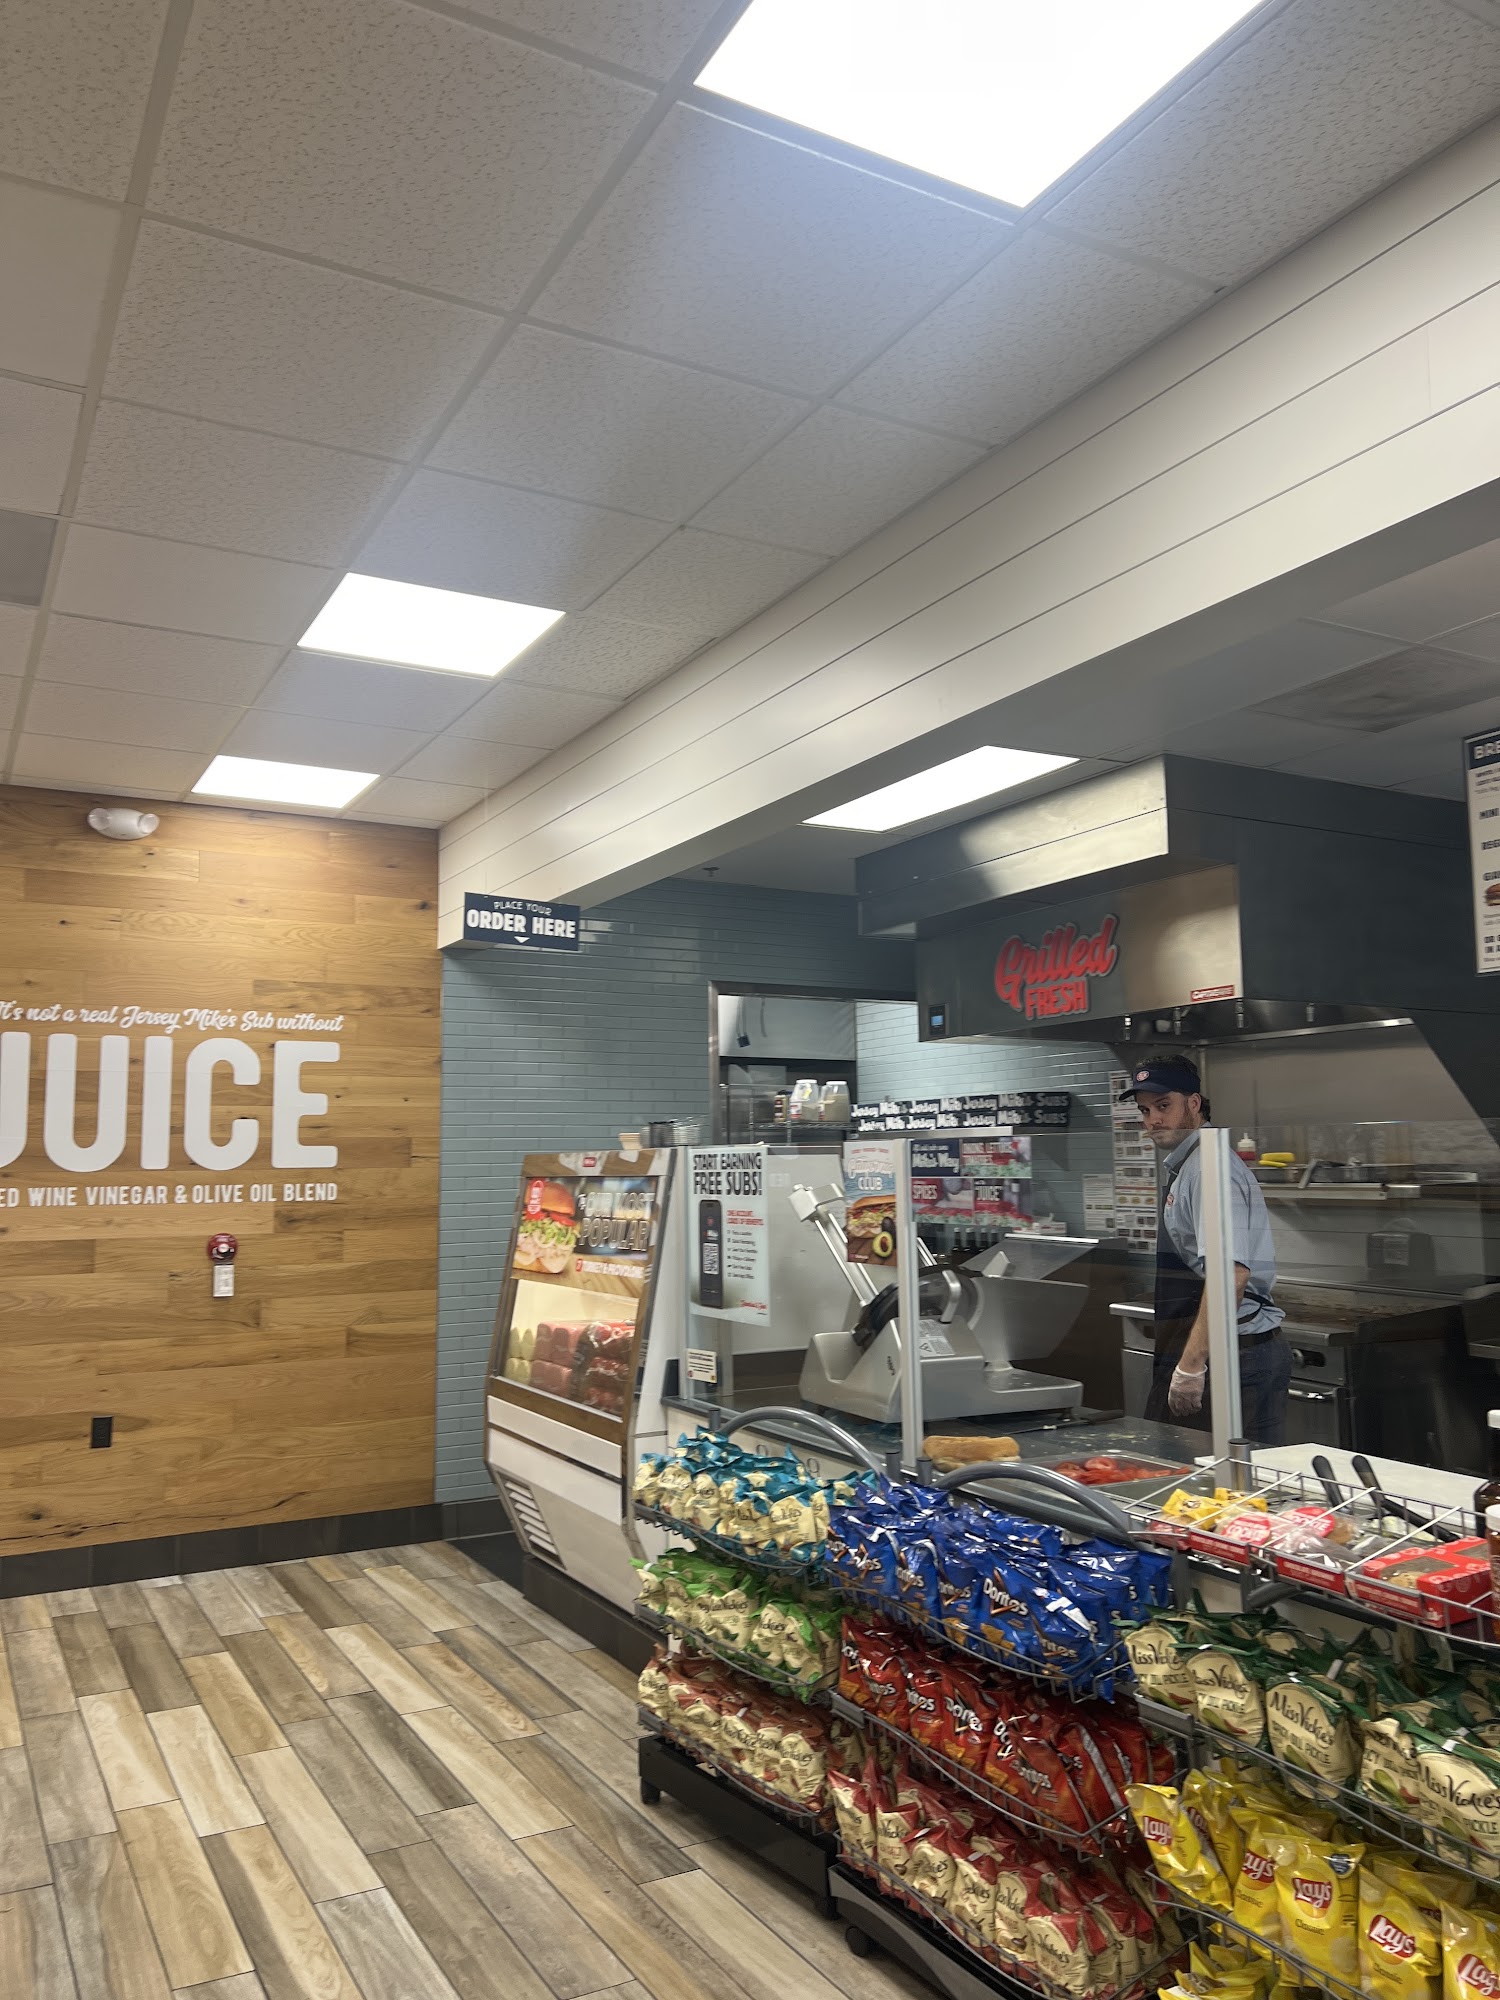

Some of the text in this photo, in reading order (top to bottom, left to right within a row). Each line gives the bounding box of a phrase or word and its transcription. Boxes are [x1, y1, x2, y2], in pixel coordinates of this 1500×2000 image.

[466, 909, 576, 939] ORDER HERE
[493, 901, 552, 916] PLACE YOUR
[996, 915, 1117, 1011] Grilled
[1025, 980, 1087, 1019] FRESH
[26, 1003, 62, 1021] not
[62, 1009, 78, 1022] a
[79, 1006, 119, 1024] real
[120, 1005, 182, 1034] Jersey
[183, 1008, 237, 1032] Mike's
[240, 1010, 274, 1032] Sub
[276, 1013, 344, 1032] without
[694, 1154, 718, 1170] START
[28, 1187, 78, 1207] WINE
[86, 1185, 168, 1205] VINEGAR
[175, 1185, 187, 1204] &
[192, 1184, 244, 1204] OLIVE
[251, 1183, 277, 1203] OIL
[283, 1182, 338, 1202] BLEND
[694, 1171, 763, 1196] FREE SUBS!
[858, 1176, 882, 1191] CLUB
[578, 1217, 650, 1252] POPULAR
[983, 1577, 1029, 1616] Doritos
[1270, 1691, 1334, 1750] Miss Vickie's
[1295, 1877, 1332, 1908] Lay's
[1295, 1918, 1325, 1936] Classic
[1370, 1917, 1415, 1954] Lay's
